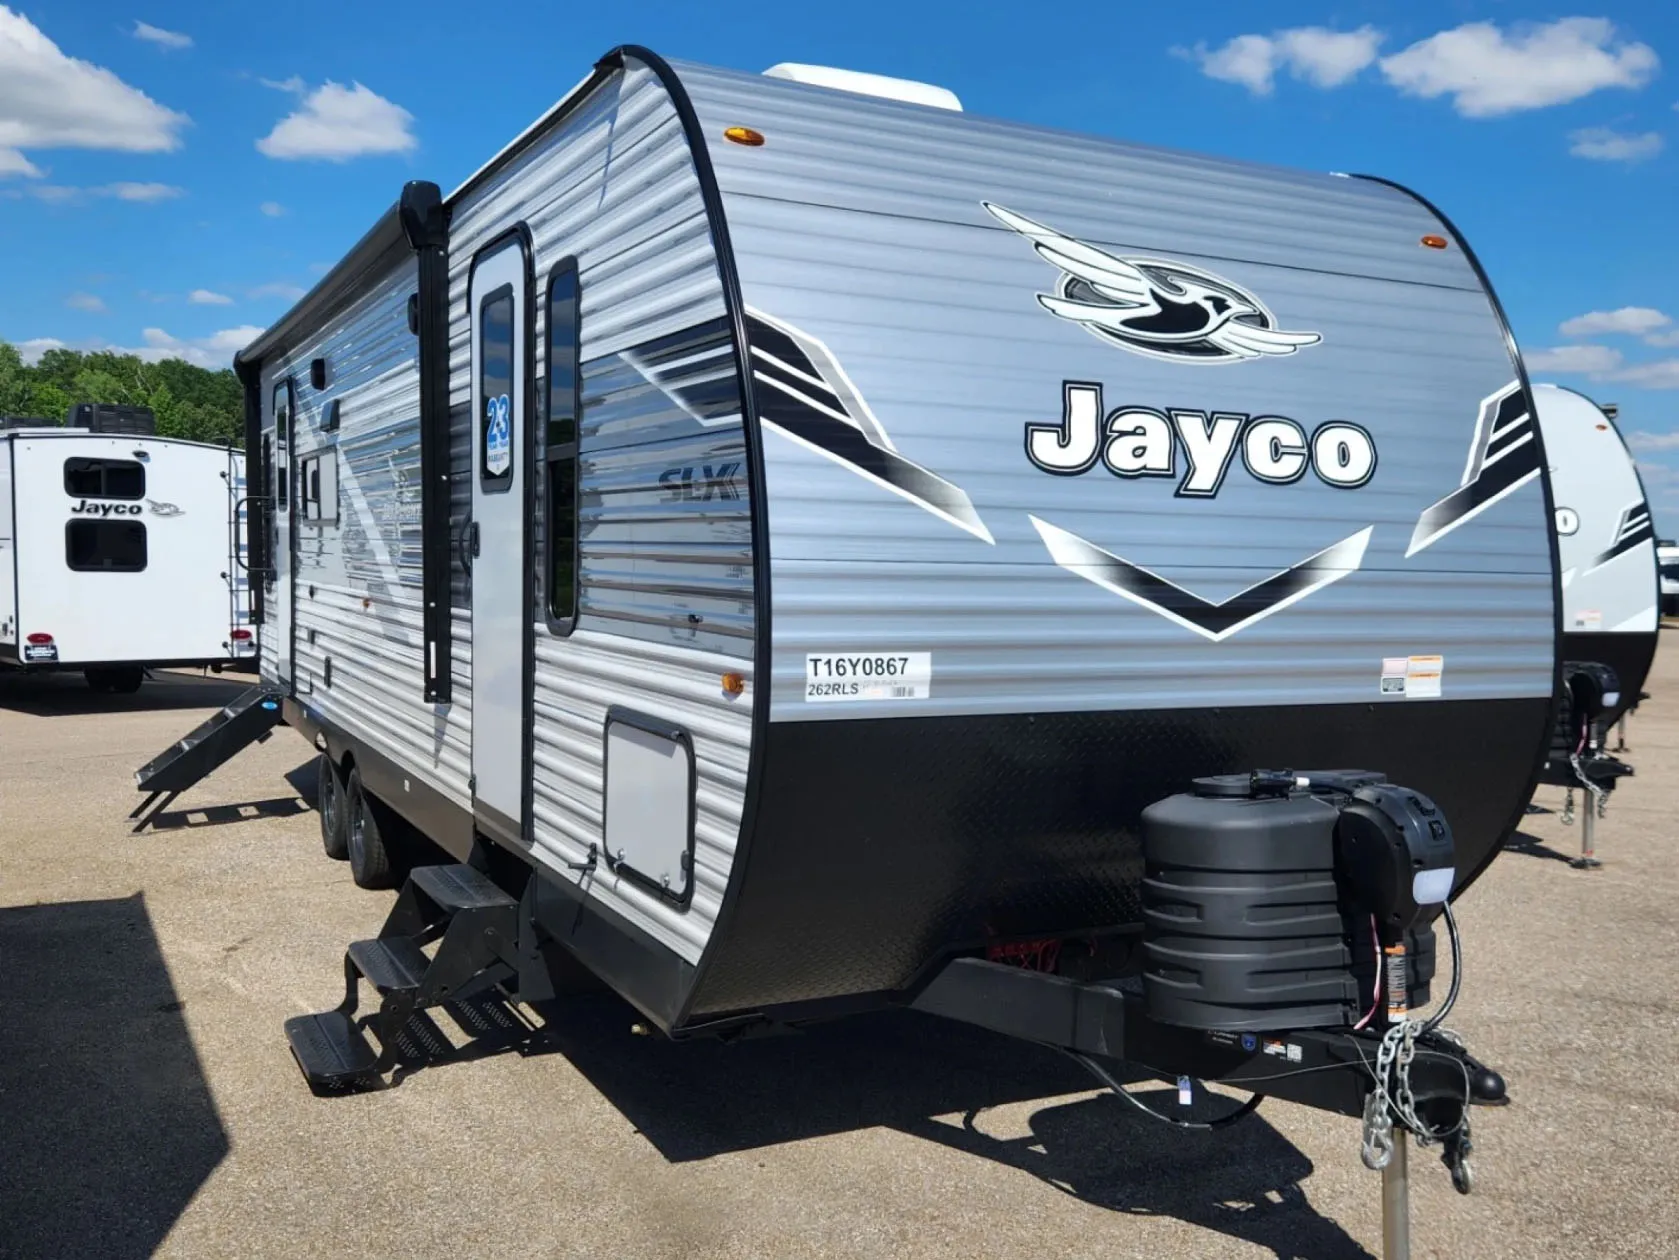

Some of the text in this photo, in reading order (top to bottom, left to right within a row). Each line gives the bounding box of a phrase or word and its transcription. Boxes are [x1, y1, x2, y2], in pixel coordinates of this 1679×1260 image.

[1024, 380, 1378, 498] Jayco
[71, 500, 142, 516] Jayco
[808, 657, 909, 677] T16Y0867
[808, 683, 859, 696] 262RLS
